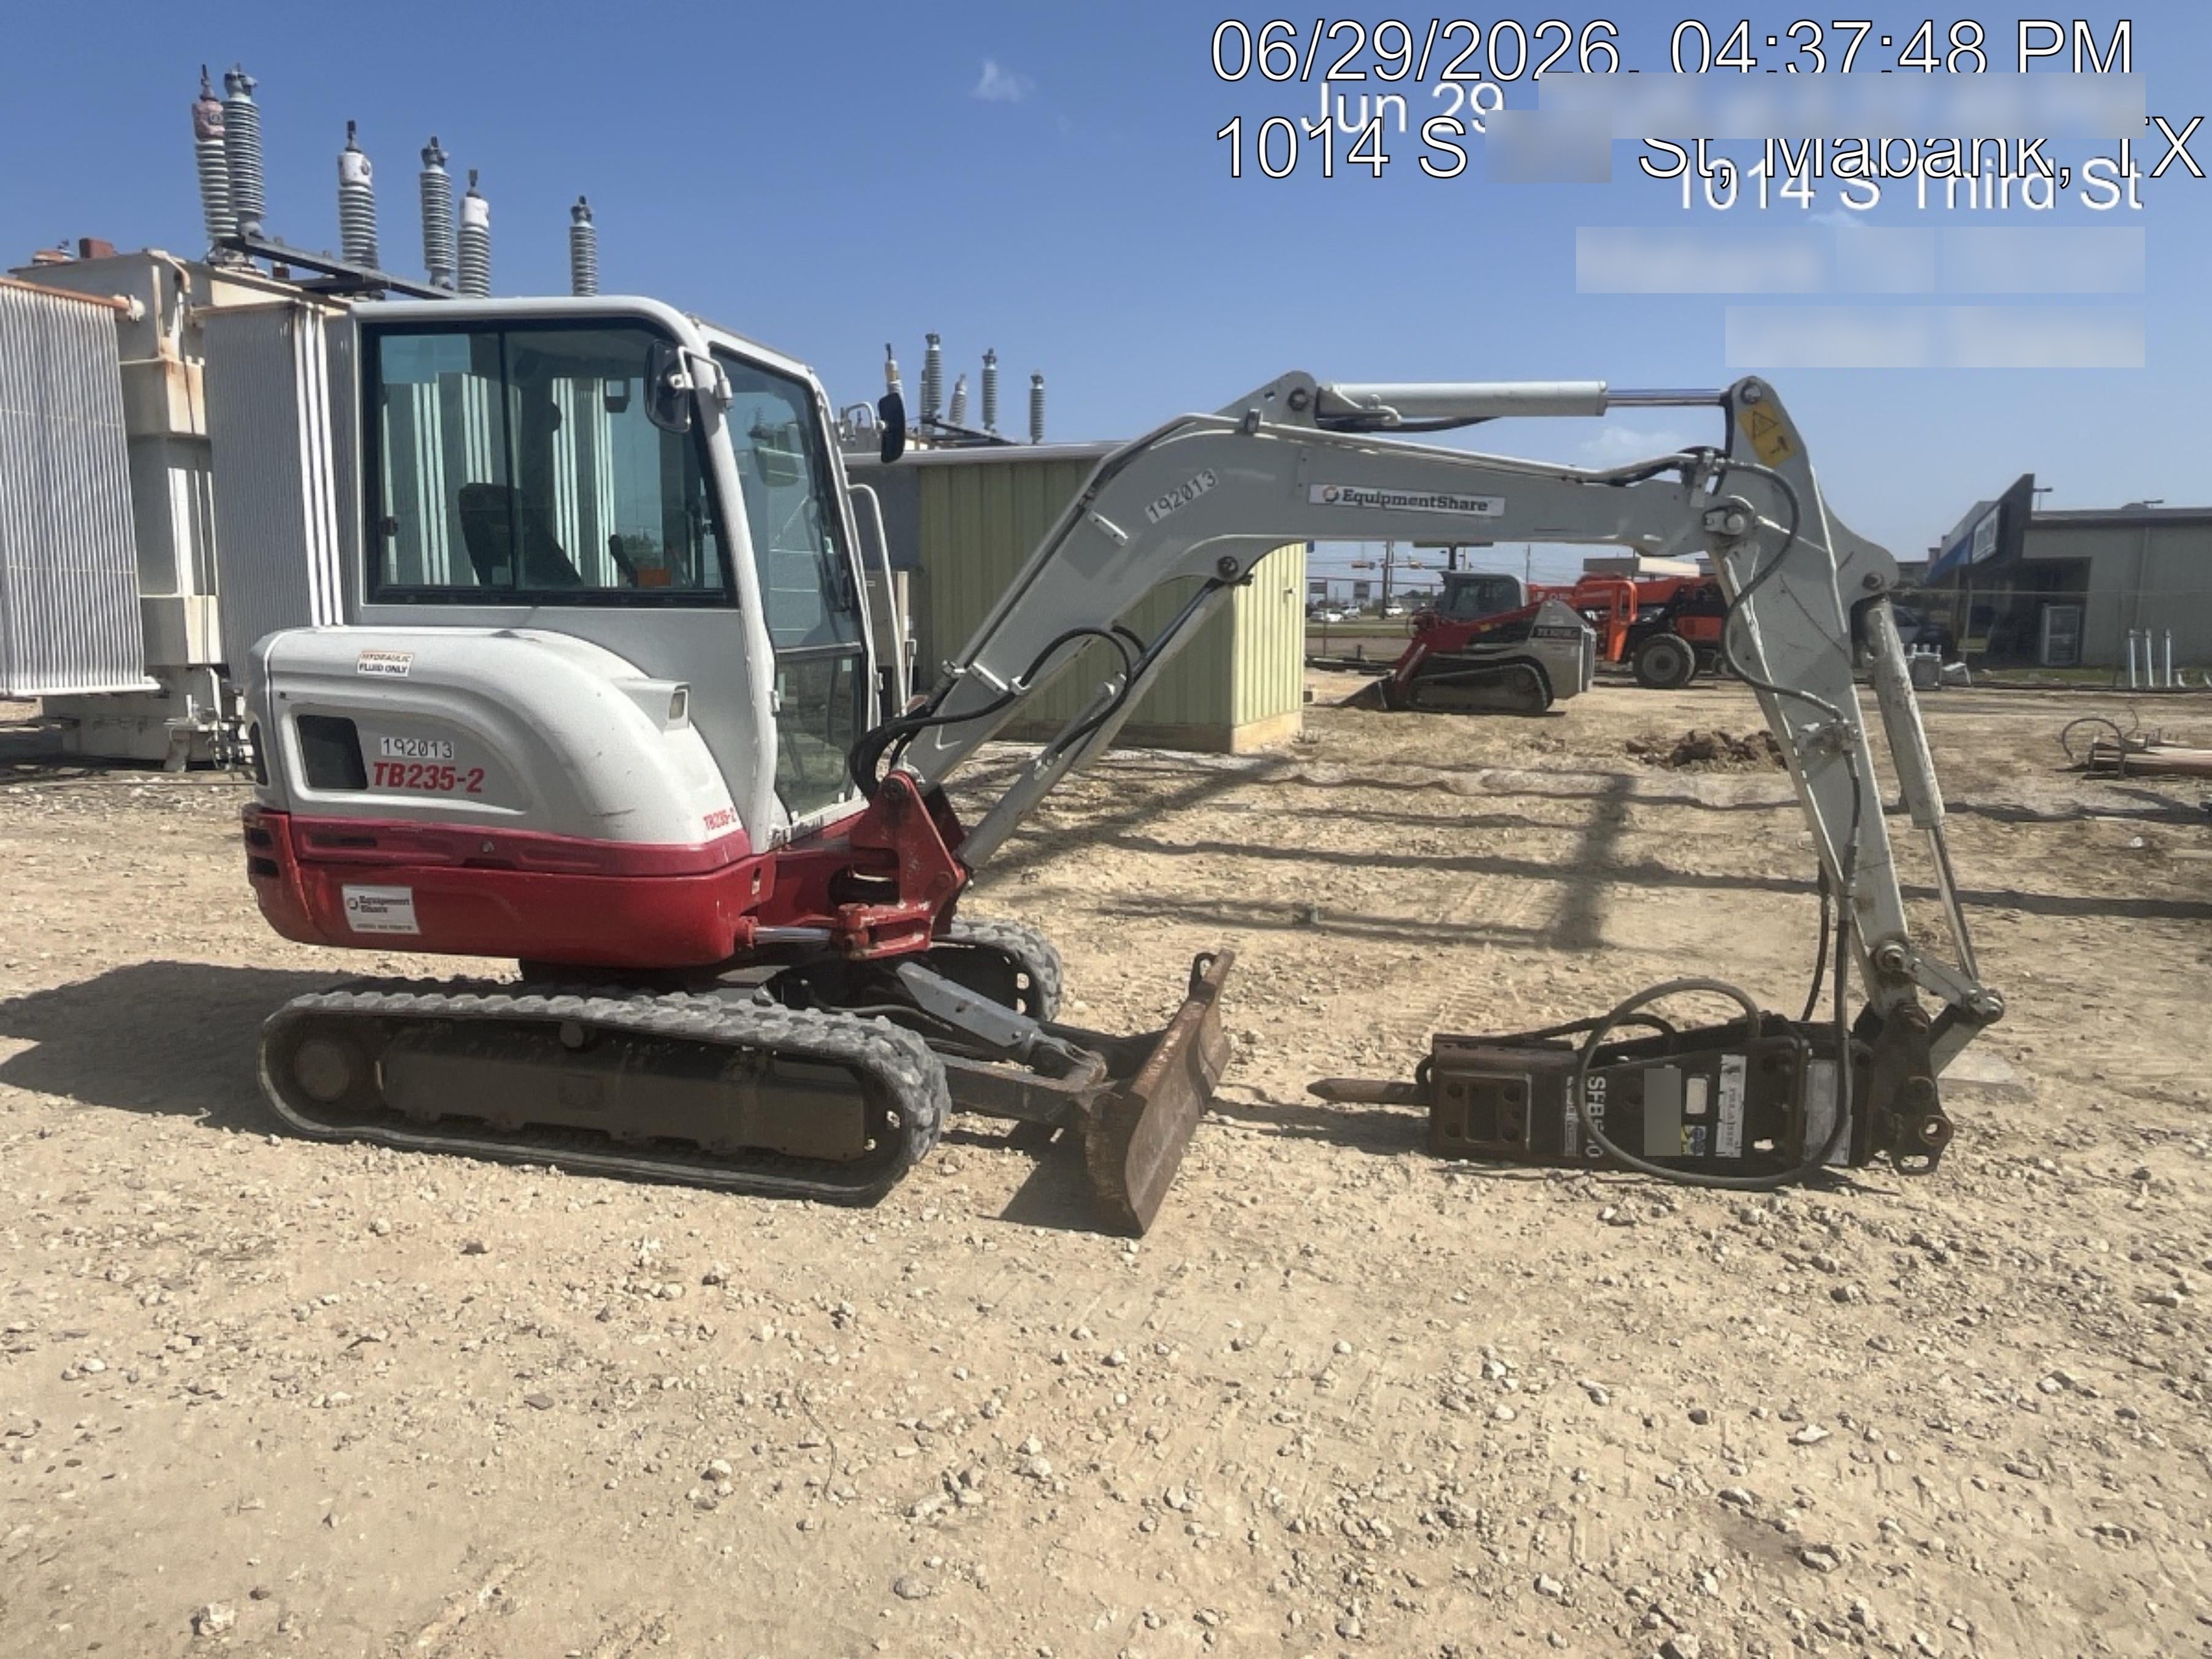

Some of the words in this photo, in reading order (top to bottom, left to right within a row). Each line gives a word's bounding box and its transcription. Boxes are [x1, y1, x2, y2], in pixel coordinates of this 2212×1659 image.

[1148, 470, 1215, 519] 192013
[1341, 488, 1489, 512] EquipmentShare
[385, 665, 408, 673] ONLY
[383, 738, 453, 758] 192013
[374, 762, 485, 793] TB235-2
